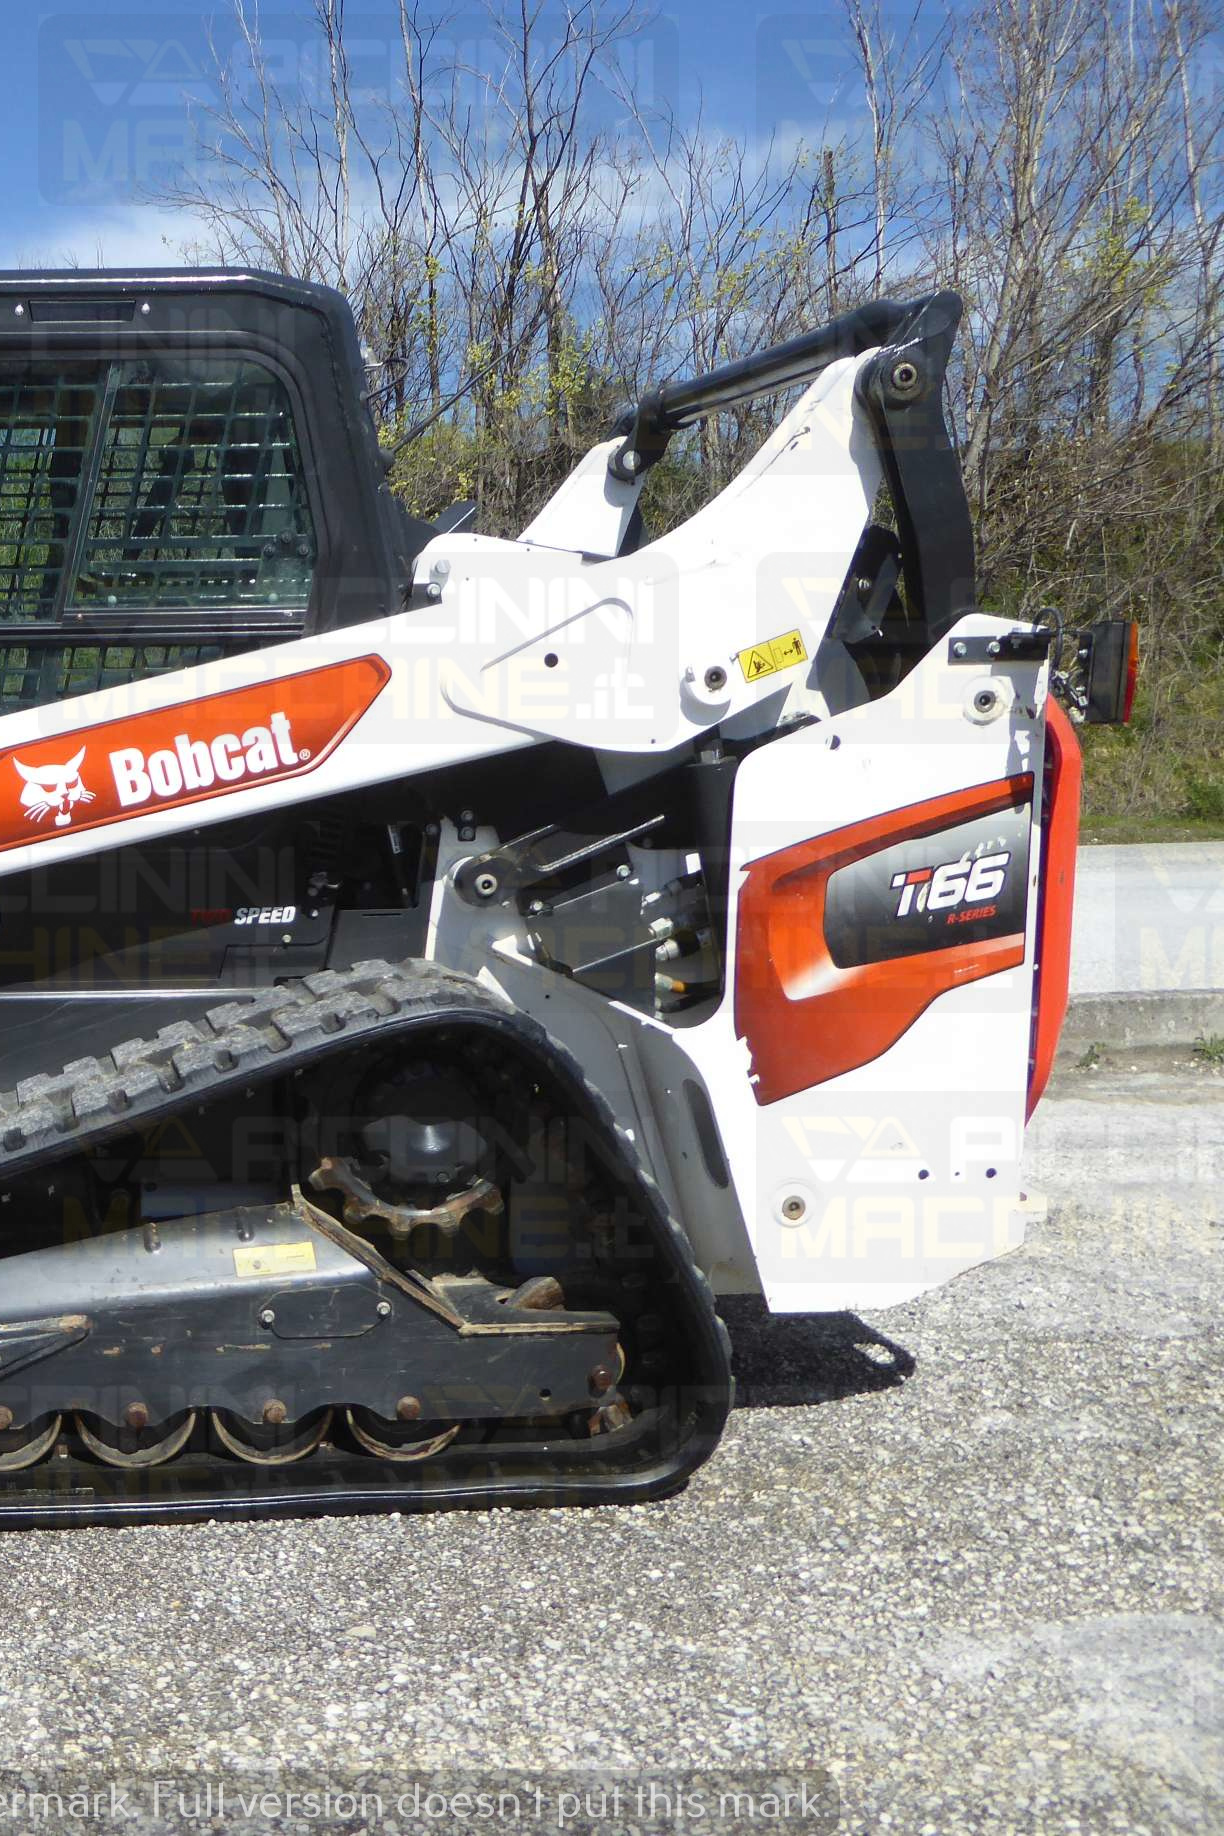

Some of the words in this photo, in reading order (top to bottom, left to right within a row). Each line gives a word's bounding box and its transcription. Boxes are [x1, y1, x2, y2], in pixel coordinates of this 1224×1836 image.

[889, 850, 1012, 920] T66
[234, 906, 296, 925] SPEED
[946, 904, 998, 925] R-SERIES
